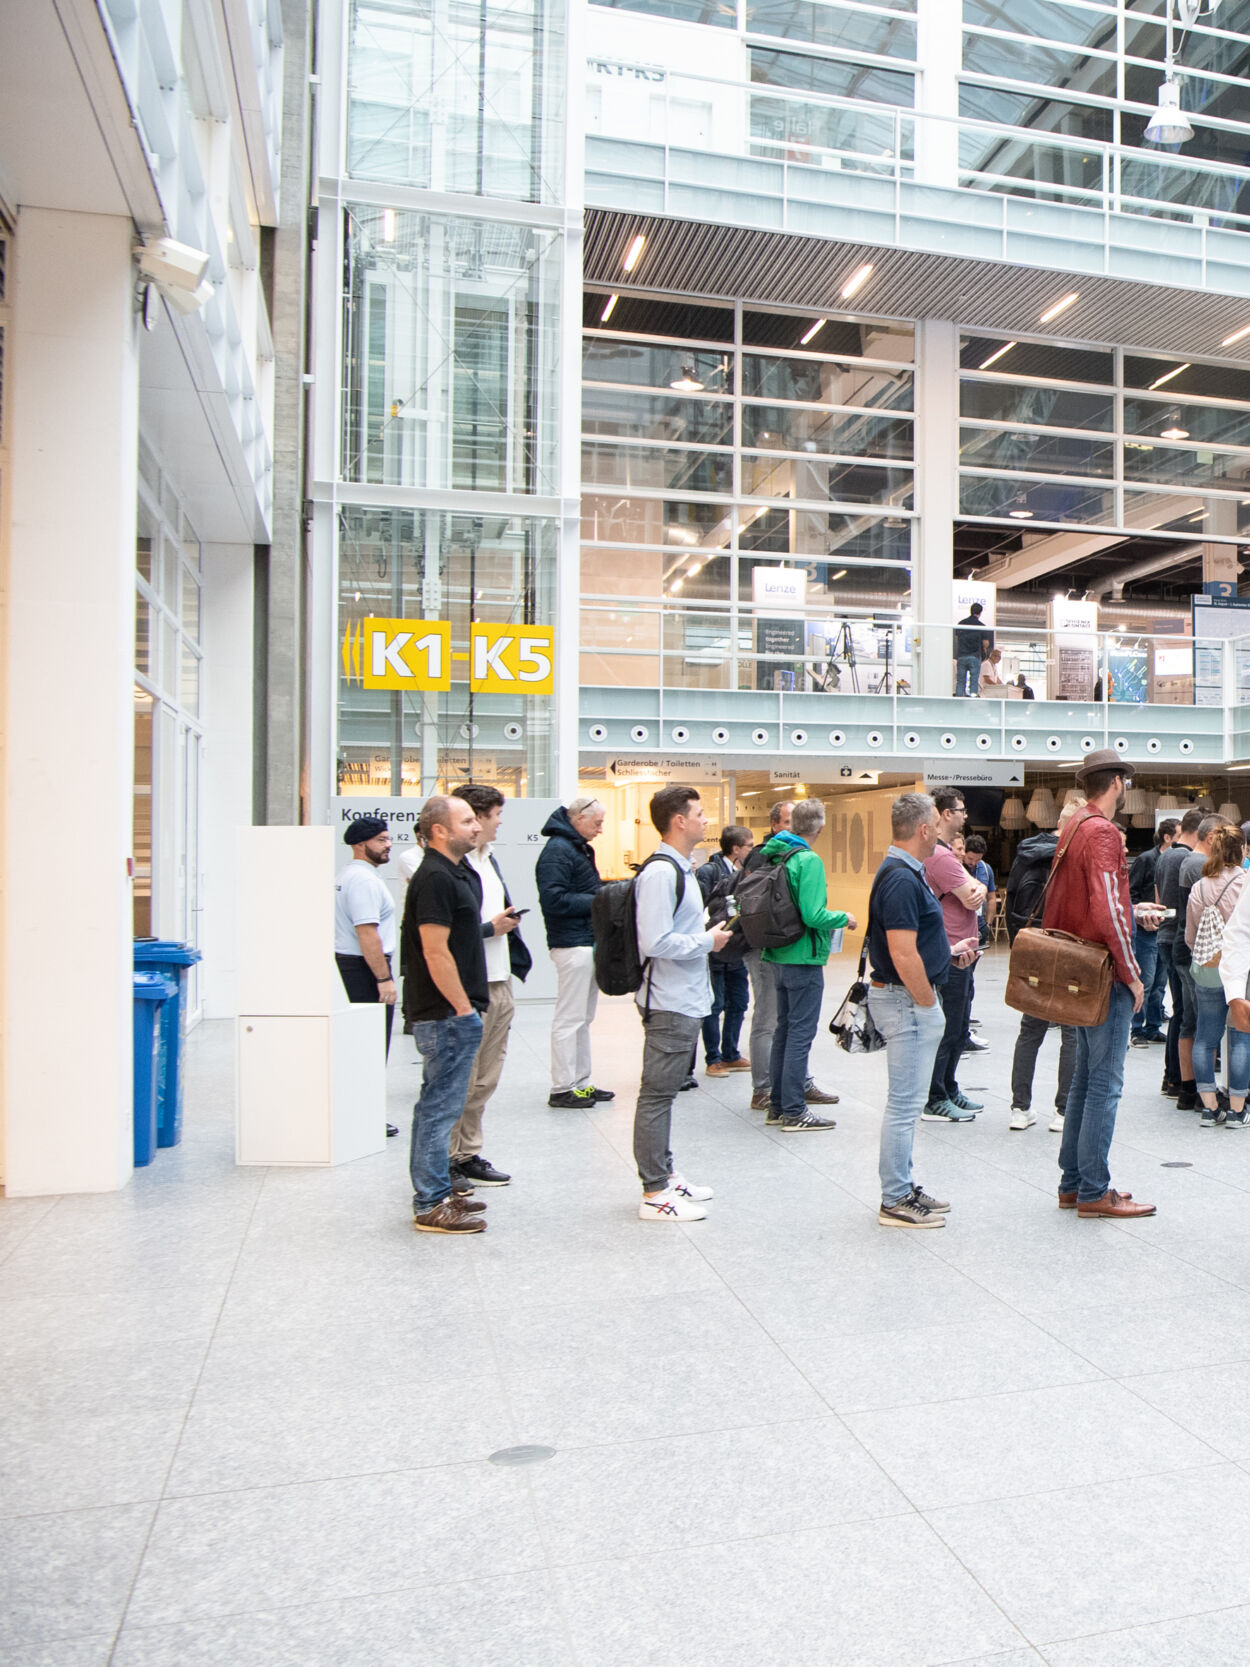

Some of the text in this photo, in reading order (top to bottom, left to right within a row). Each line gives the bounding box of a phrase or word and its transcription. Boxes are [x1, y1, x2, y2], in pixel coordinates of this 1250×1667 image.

[765, 583, 796, 594] Lenze
[958, 595, 987, 606] Lenze
[617, 759, 658, 767] Garderobe
[774, 771, 800, 779] Sanität
[527, 833, 539, 843] K5
